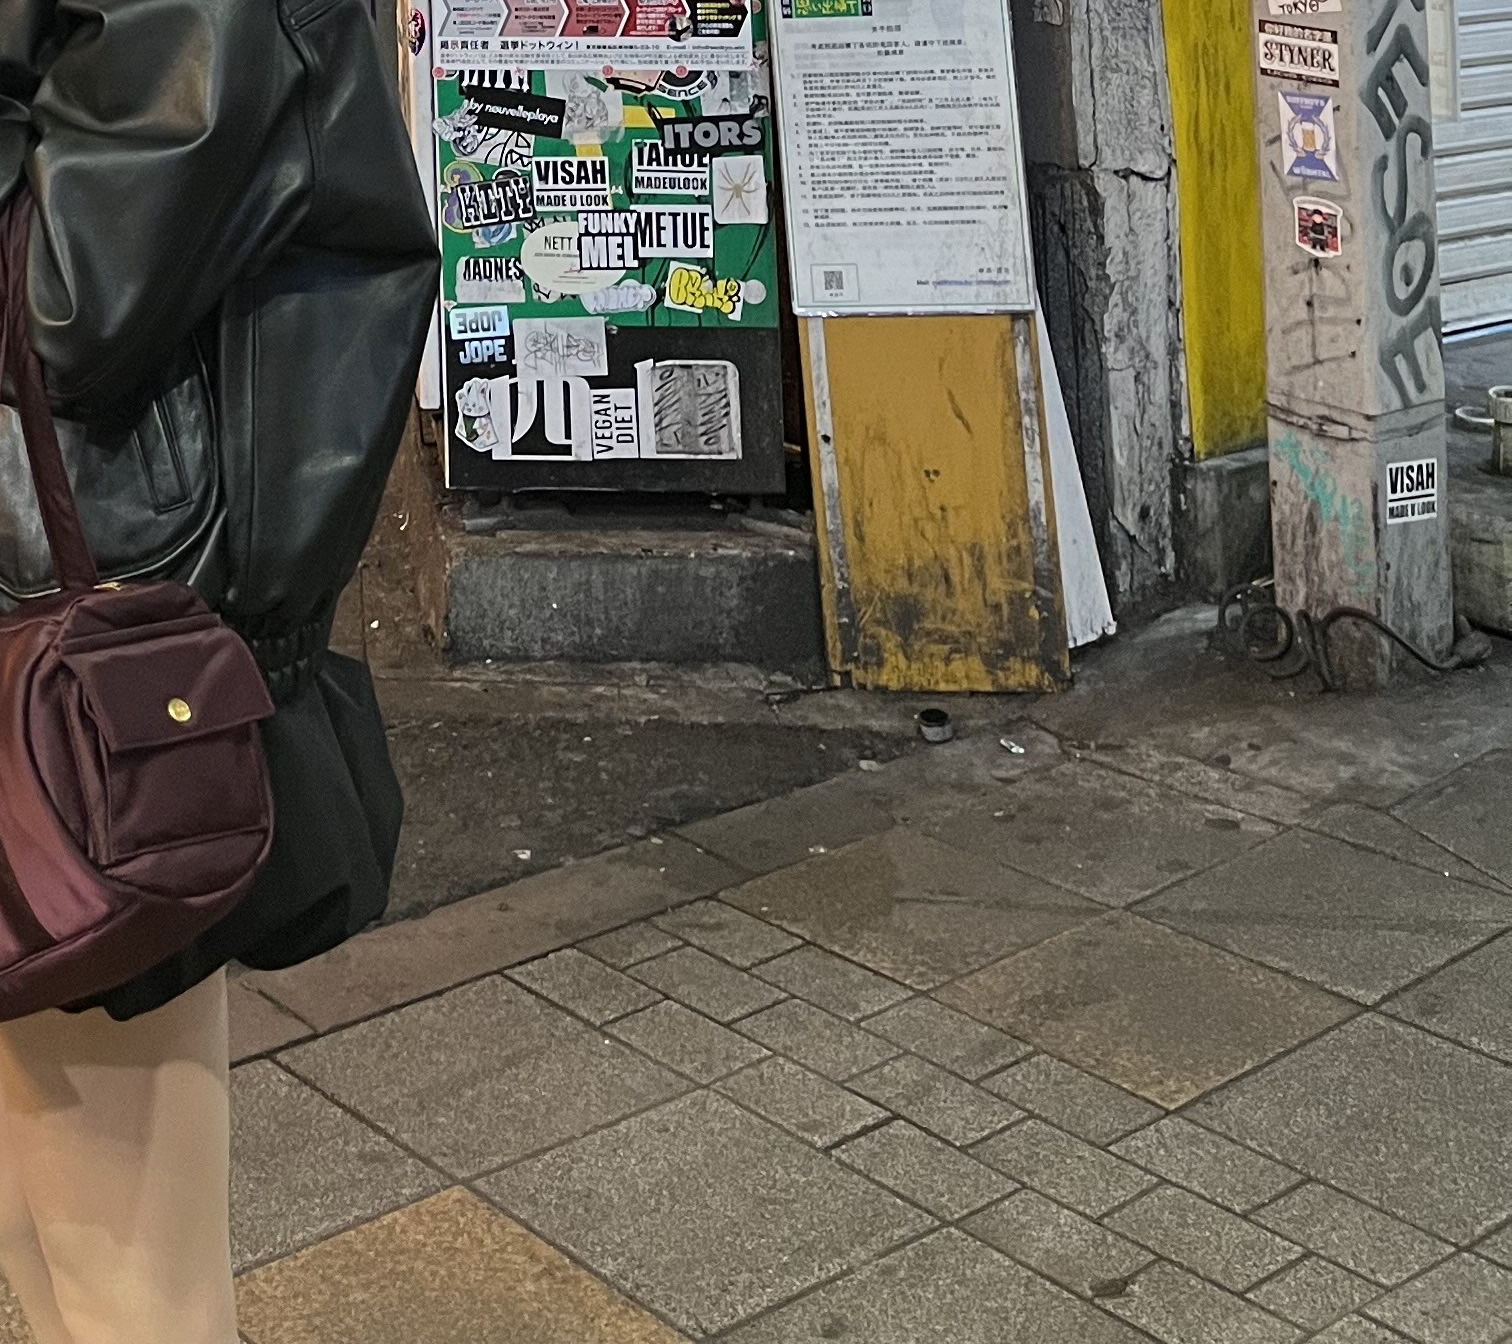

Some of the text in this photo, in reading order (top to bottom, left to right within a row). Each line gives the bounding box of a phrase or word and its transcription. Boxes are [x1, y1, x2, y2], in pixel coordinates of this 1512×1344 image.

[1264, 40, 1336, 72] STYNER
[663, 121, 763, 150] ITORS
[536, 159, 607, 185] VISAH
[634, 175, 708, 190] MADEULOOK
[536, 193, 609, 208] MADE U LOOK
[577, 212, 639, 235] FUNKY
[638, 211, 711, 250] METUE
[579, 236, 639, 270] MEL
[459, 339, 507, 364] JOPE
[593, 392, 612, 455] VEGAN
[616, 403, 635, 445] DIET
[1388, 462, 1435, 494] VISAH
